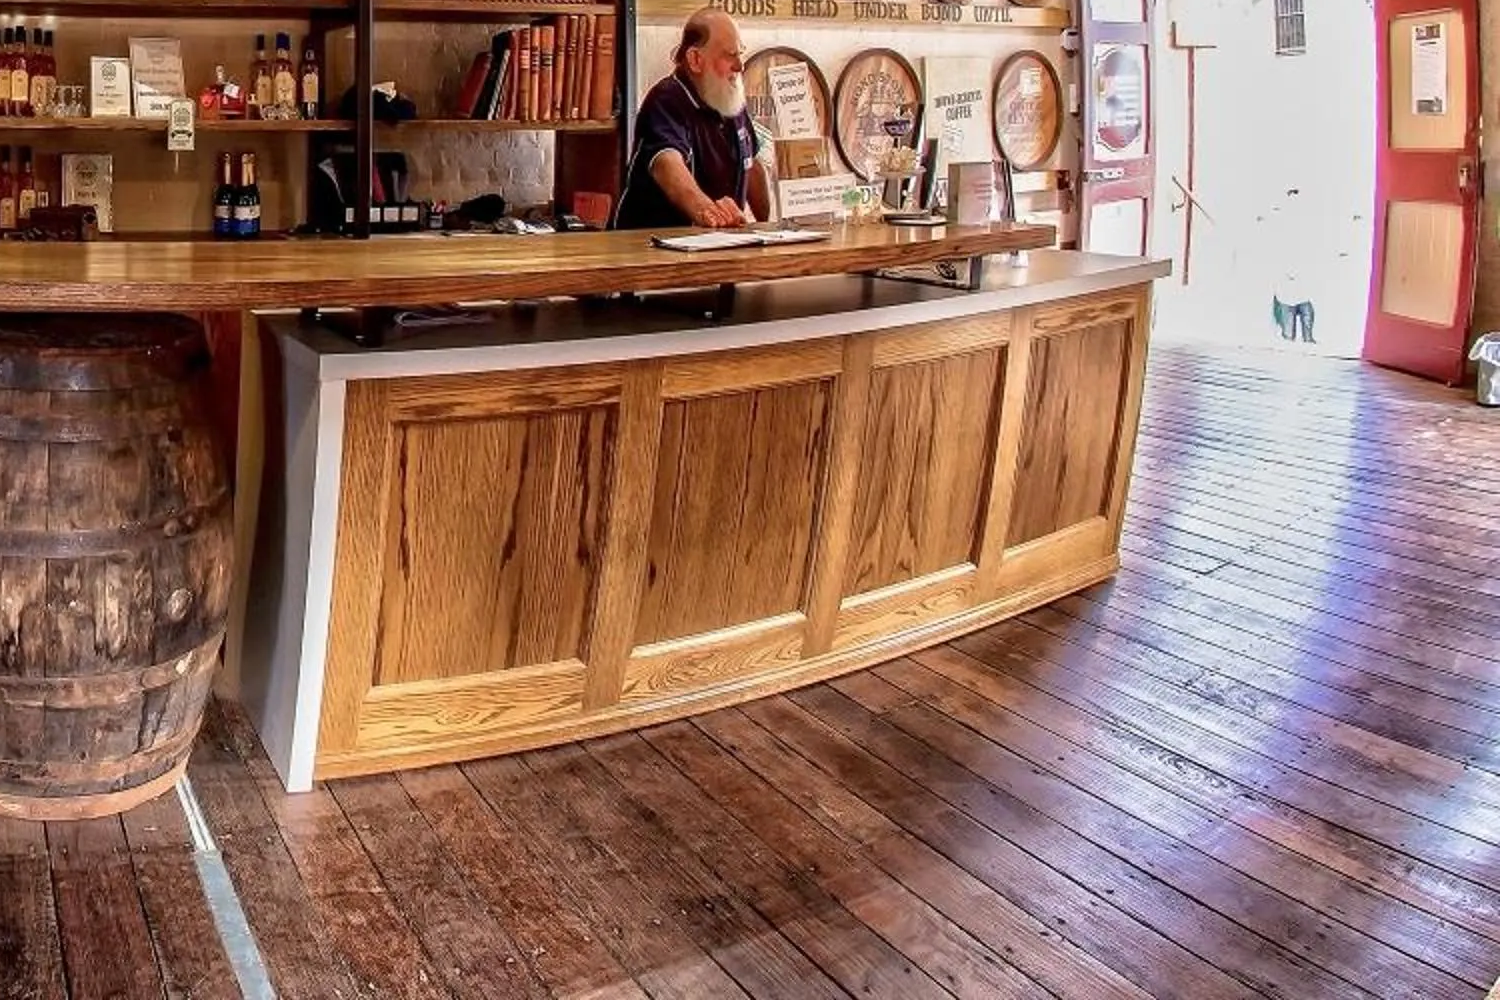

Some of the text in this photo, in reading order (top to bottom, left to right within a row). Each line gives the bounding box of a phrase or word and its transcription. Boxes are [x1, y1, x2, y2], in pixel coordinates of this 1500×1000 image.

[792, 0, 839, 18] HELD
[853, 1, 909, 21] UNDER
[921, 3, 963, 23] BOND
